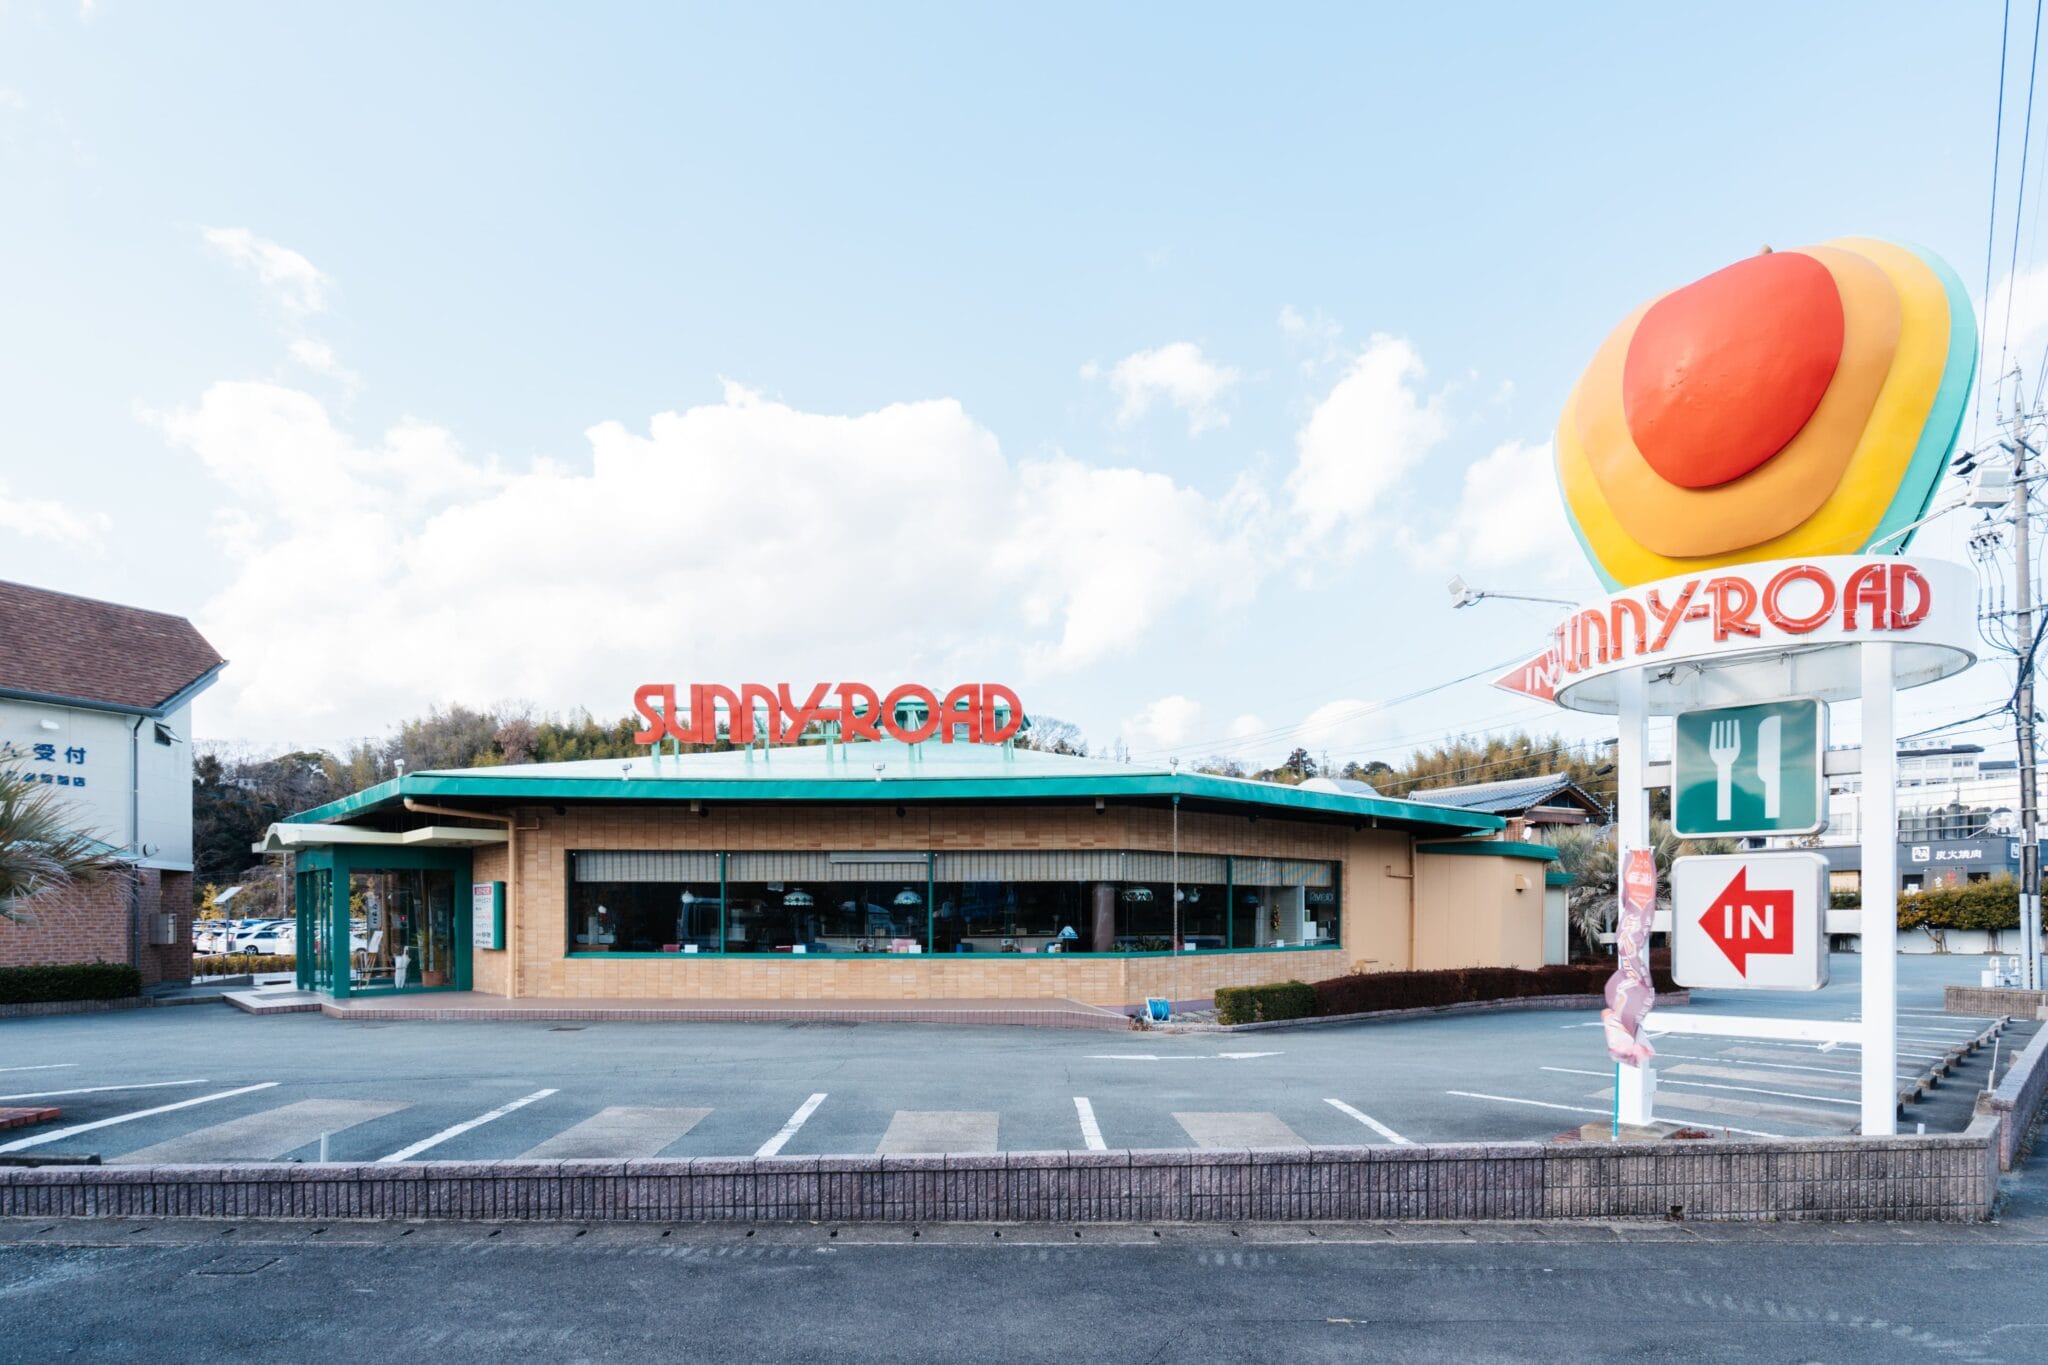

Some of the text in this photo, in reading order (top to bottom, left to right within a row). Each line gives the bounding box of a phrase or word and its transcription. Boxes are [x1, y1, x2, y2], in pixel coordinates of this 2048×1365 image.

[634, 683, 1023, 745] SUNNY-ROAD
[3, 741, 87, 765] 受付
[1723, 904, 1775, 940] IN
